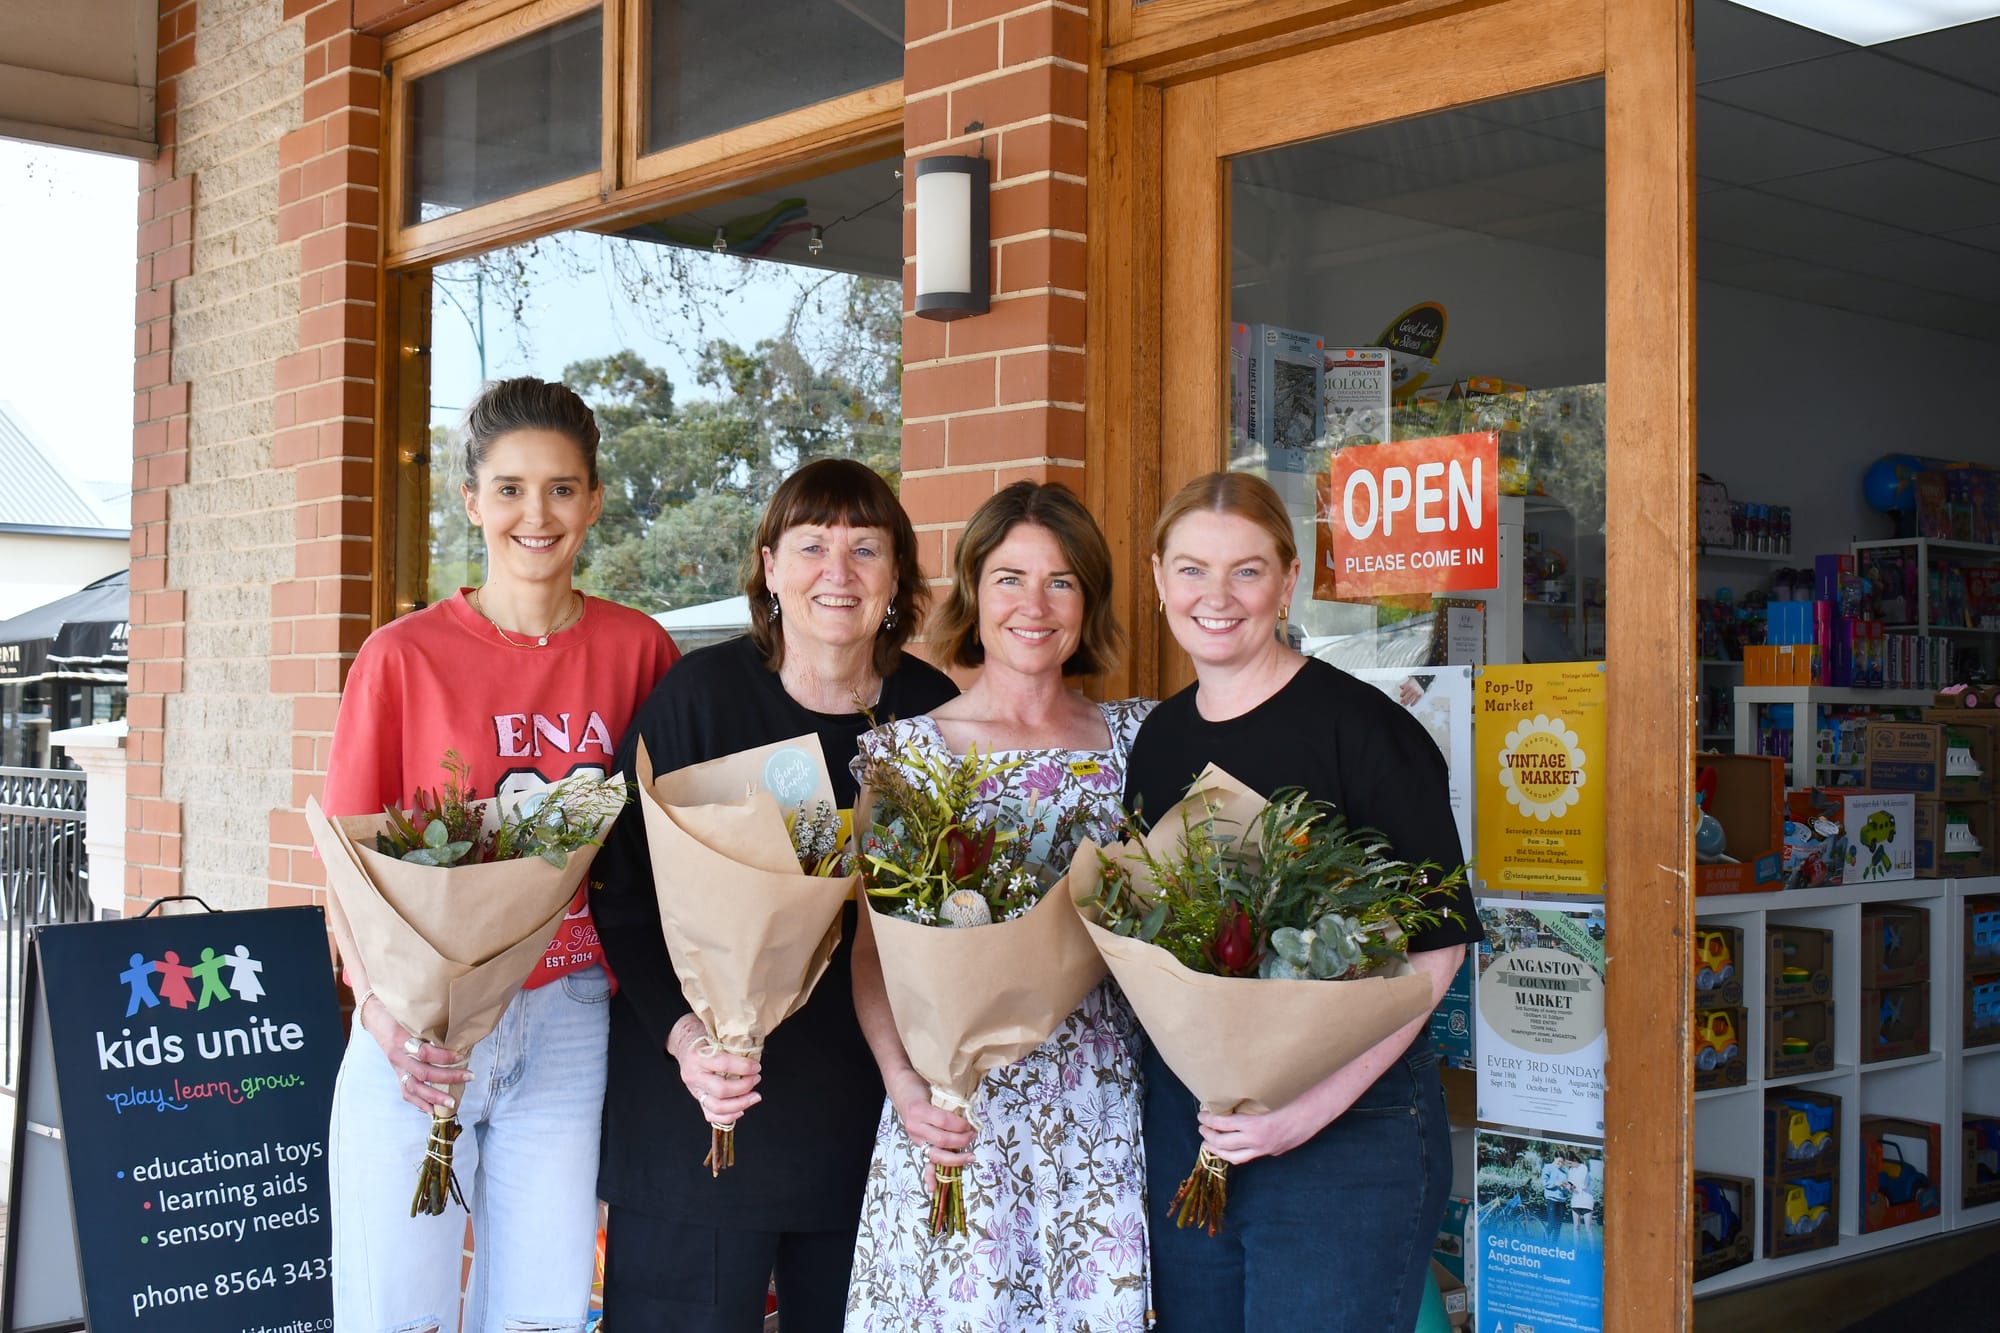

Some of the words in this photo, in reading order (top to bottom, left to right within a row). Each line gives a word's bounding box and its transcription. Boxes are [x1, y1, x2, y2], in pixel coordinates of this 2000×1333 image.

[1348, 369, 1382, 377] DISCOVER
[1343, 457, 1482, 541] OPEN
[1346, 554, 1406, 574] PLEASE
[1410, 550, 1461, 569] COME
[1466, 547, 1484, 565] IN
[1485, 680, 1533, 696] Pop-Up
[1485, 699, 1534, 712] Market
[493, 711, 614, 758] ENA
[1505, 754, 1566, 768] VINTAGE
[1521, 770, 1579, 785] MARKET
[1560, 915, 1584, 938] UNDER
[1582, 935, 1601, 951] NEW
[1551, 921, 1599, 963] MANAGEMENT
[544, 956, 569, 968] EST.
[571, 952, 593, 964] 2014
[1507, 958, 1580, 976] ANGASTON
[1519, 977, 1567, 991] COUNTRY
[1515, 992, 1573, 1009] MARKET
[96, 1025, 185, 1070] kids
[196, 1015, 305, 1060] unite
[1487, 1055, 1522, 1070] EVERY
[1527, 1059, 1549, 1073] 3RD
[1551, 1063, 1601, 1080] SUNDAY
[1490, 1070, 1503, 1078] June
[1490, 1079, 1503, 1088] Sept
[1504, 1080, 1516, 1089] 17th
[1526, 1083, 1549, 1093] October
[1531, 1075, 1543, 1084] July
[1567, 1079, 1590, 1089] August
[1571, 1089, 1585, 1097] Nov
[1586, 1091, 1600, 1100] 19th
[133, 1143, 270, 1182] educational
[274, 1141, 323, 1166] toys
[159, 1182, 258, 1213] learning
[262, 1172, 308, 1198] aids
[156, 1218, 246, 1248] sensory
[253, 1203, 320, 1233] needs
[1487, 1235, 1508, 1248] Get
[1510, 1239, 1576, 1261] Connected
[1487, 1249, 1541, 1269] Angaston
[132, 1284, 209, 1318] phone
[214, 1266, 277, 1297] 8564
